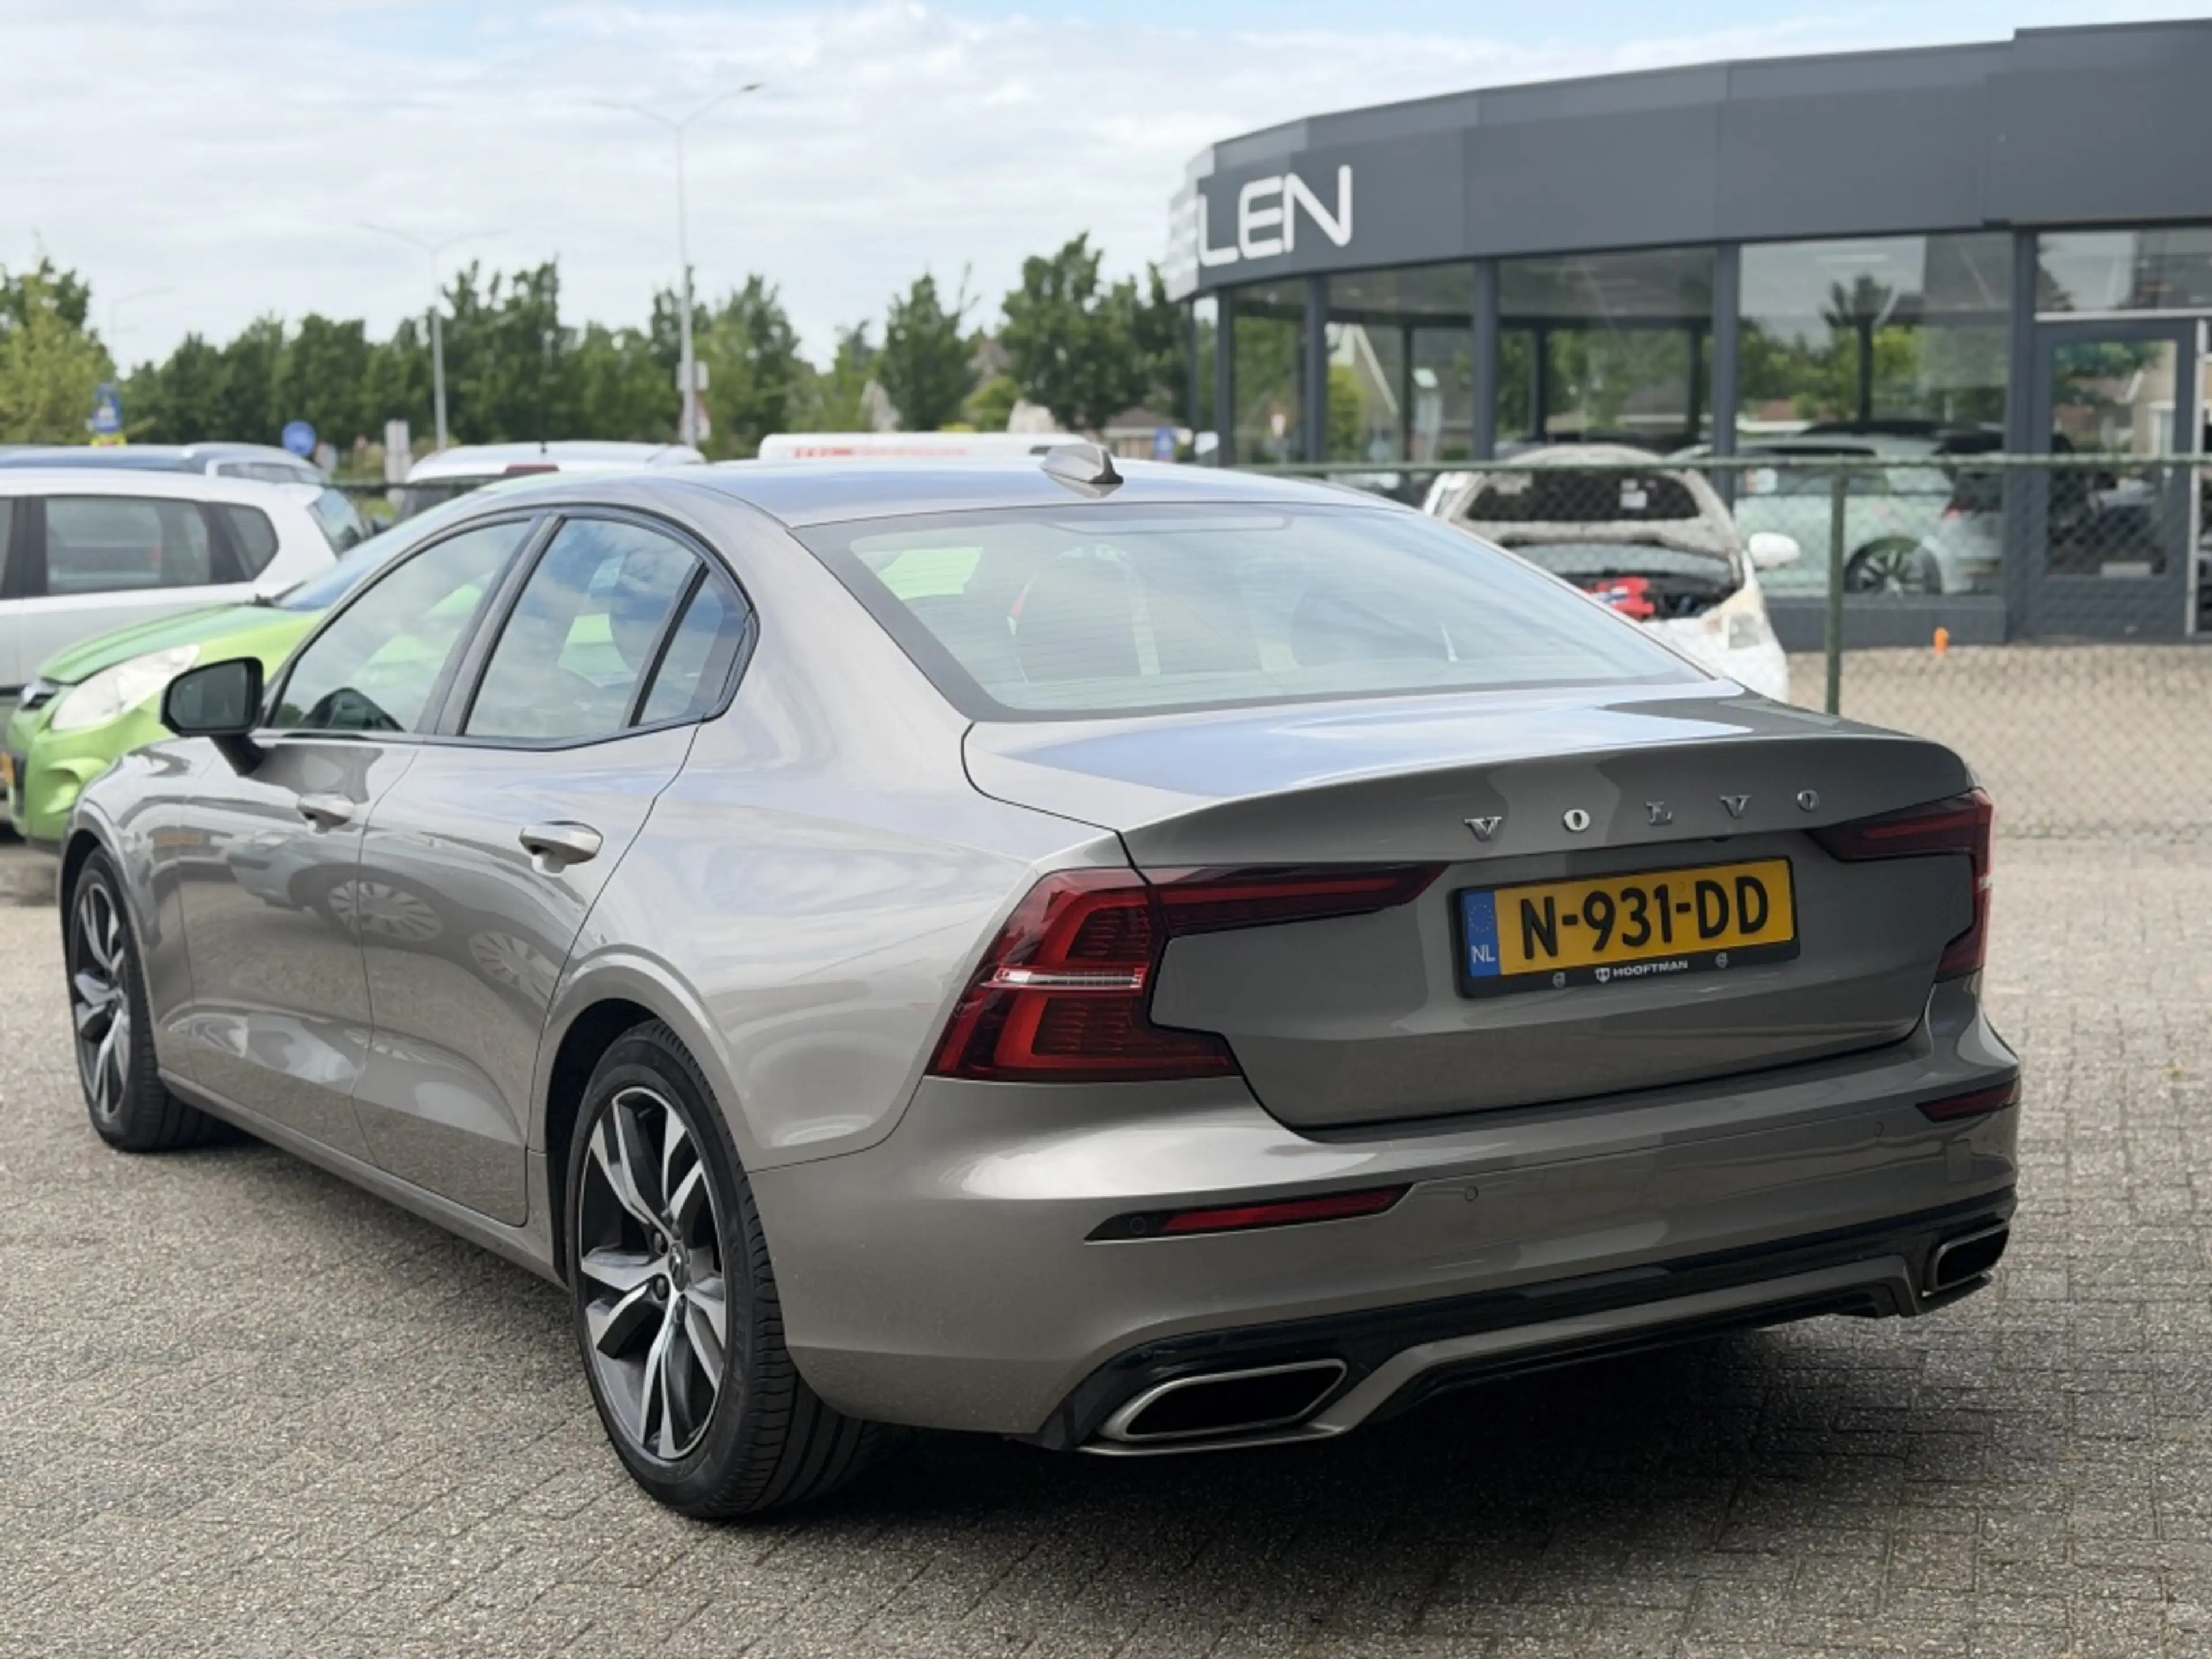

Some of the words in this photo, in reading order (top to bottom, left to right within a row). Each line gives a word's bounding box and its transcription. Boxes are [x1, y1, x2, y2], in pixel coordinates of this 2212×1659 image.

[1464, 789, 1820, 842] VOLVO
[1520, 876, 1770, 960] N-931-DD
[1471, 944, 1497, 964] NL
[1613, 961, 1688, 978] HOOFTMAN
